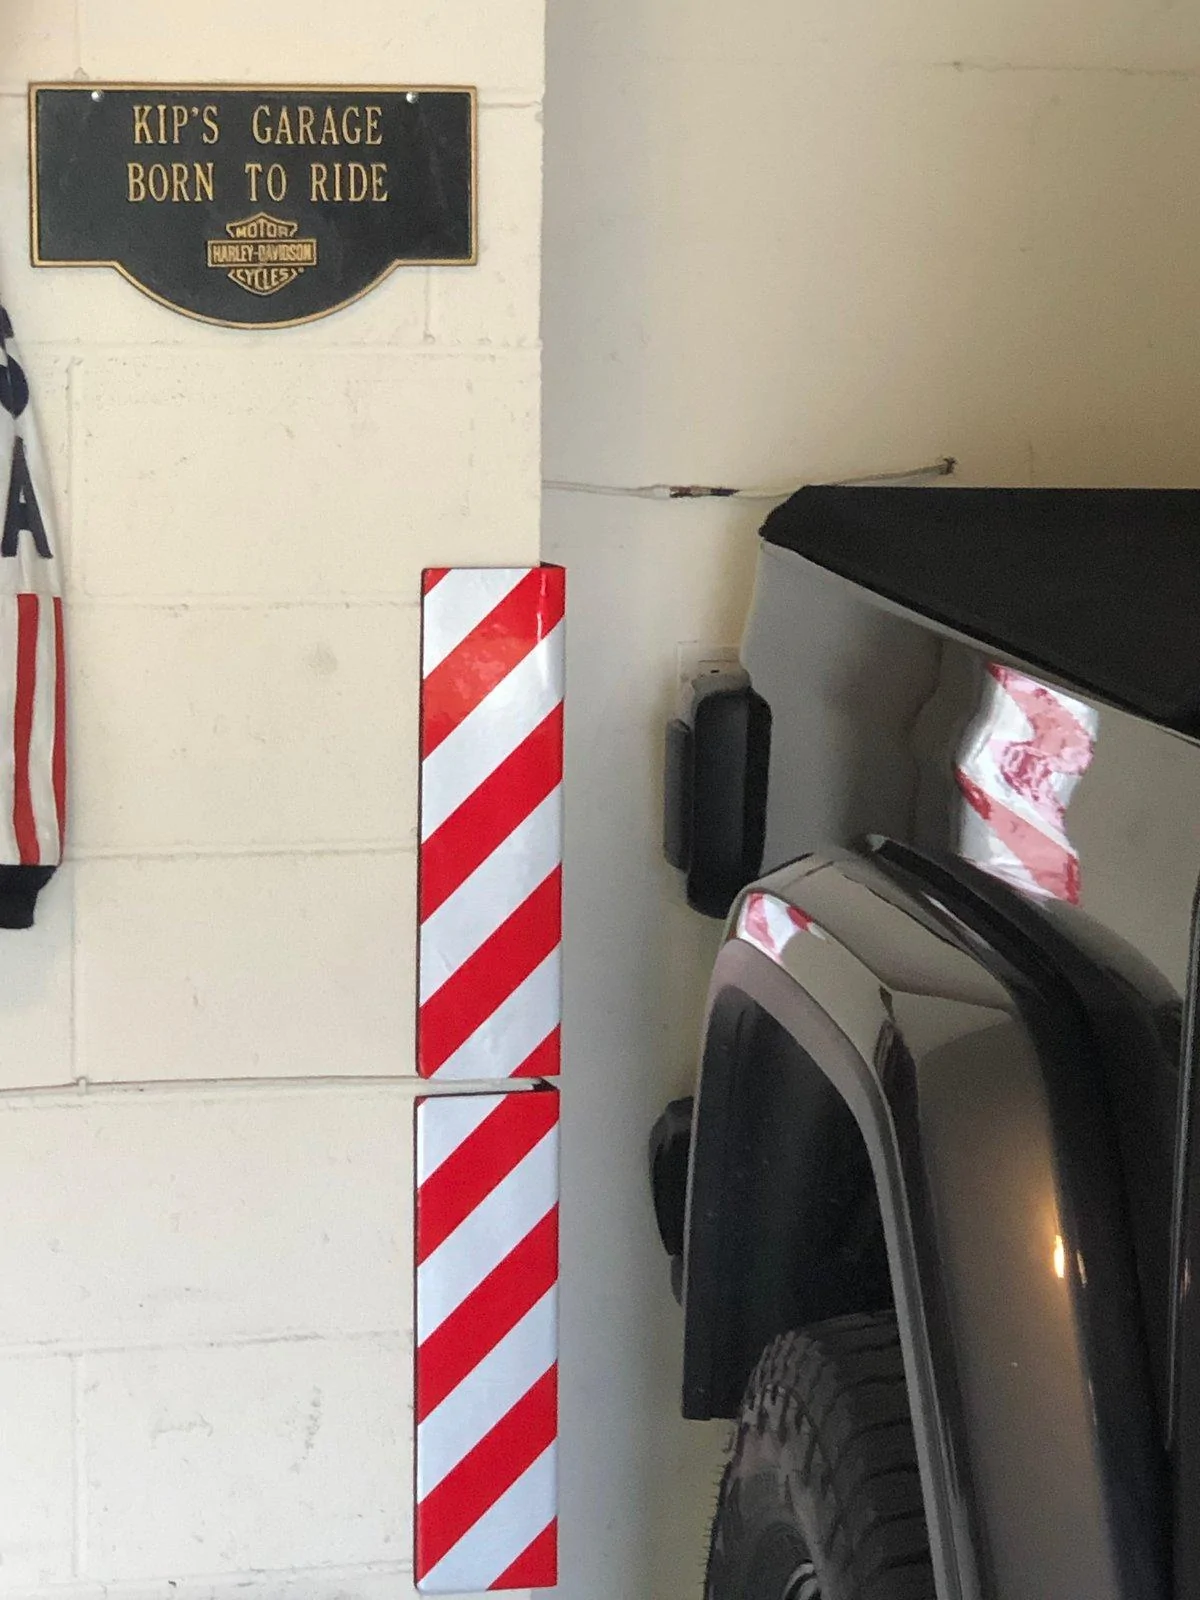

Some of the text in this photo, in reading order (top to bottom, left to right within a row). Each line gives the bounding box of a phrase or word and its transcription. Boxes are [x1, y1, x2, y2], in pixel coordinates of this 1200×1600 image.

[133, 104, 383, 145] KIP'S GARAGE
[127, 162, 389, 202] BORN TO RIDE
[235, 219, 289, 238] MOTOR
[213, 243, 312, 263] HARLEY-DAVIDSON
[236, 267, 290, 290] CYCLES
